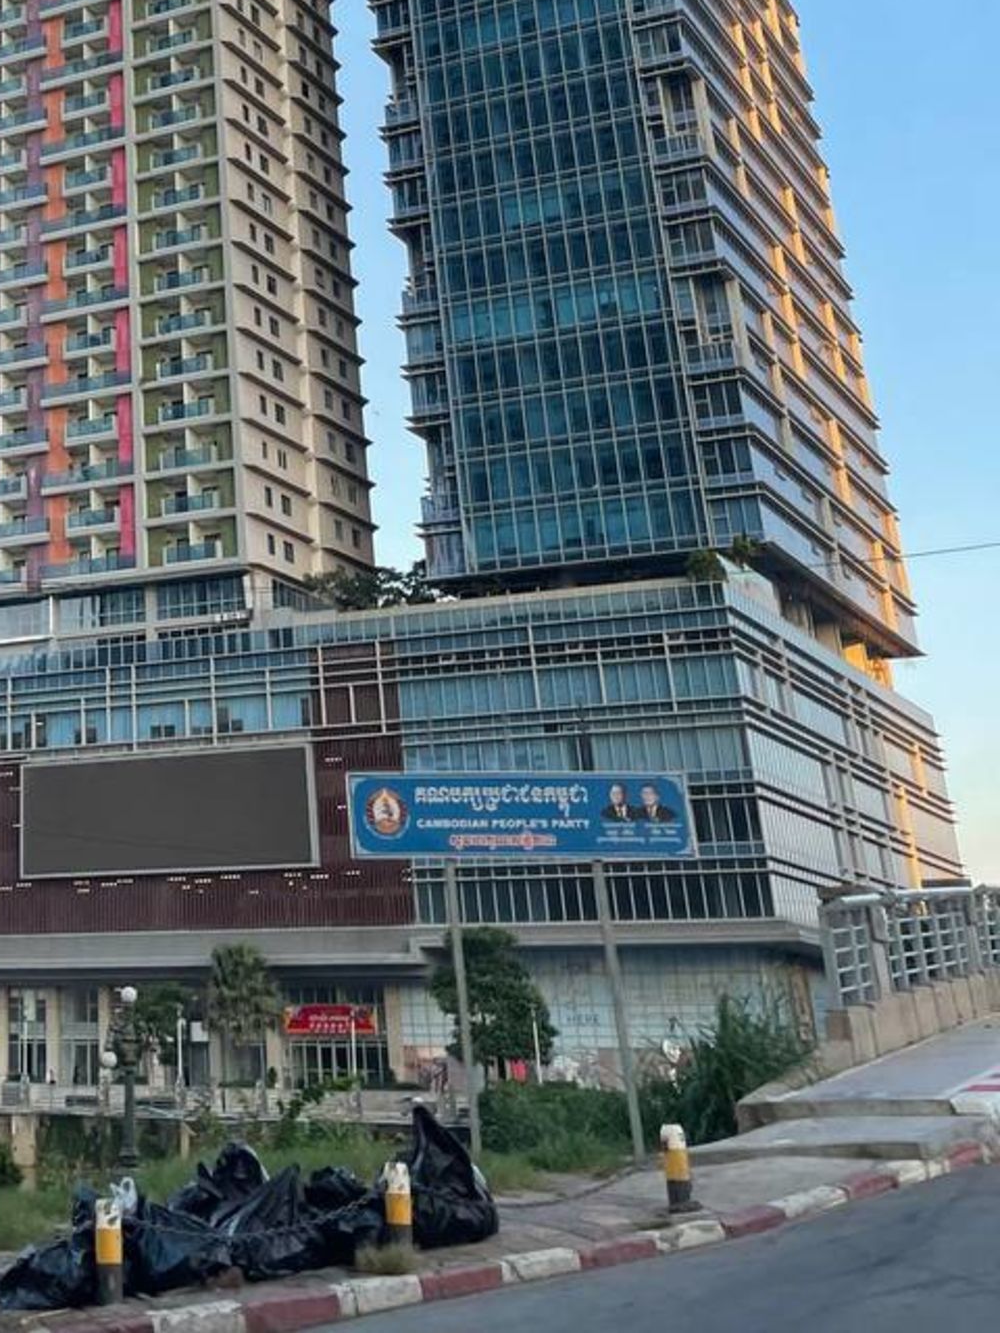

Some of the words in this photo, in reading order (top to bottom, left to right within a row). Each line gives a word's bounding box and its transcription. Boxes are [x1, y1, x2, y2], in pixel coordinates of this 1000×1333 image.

[416, 818, 489, 829] CAMBODIAN
[491, 818, 549, 829] PEOPLE'S
[551, 818, 590, 829] PARTY
